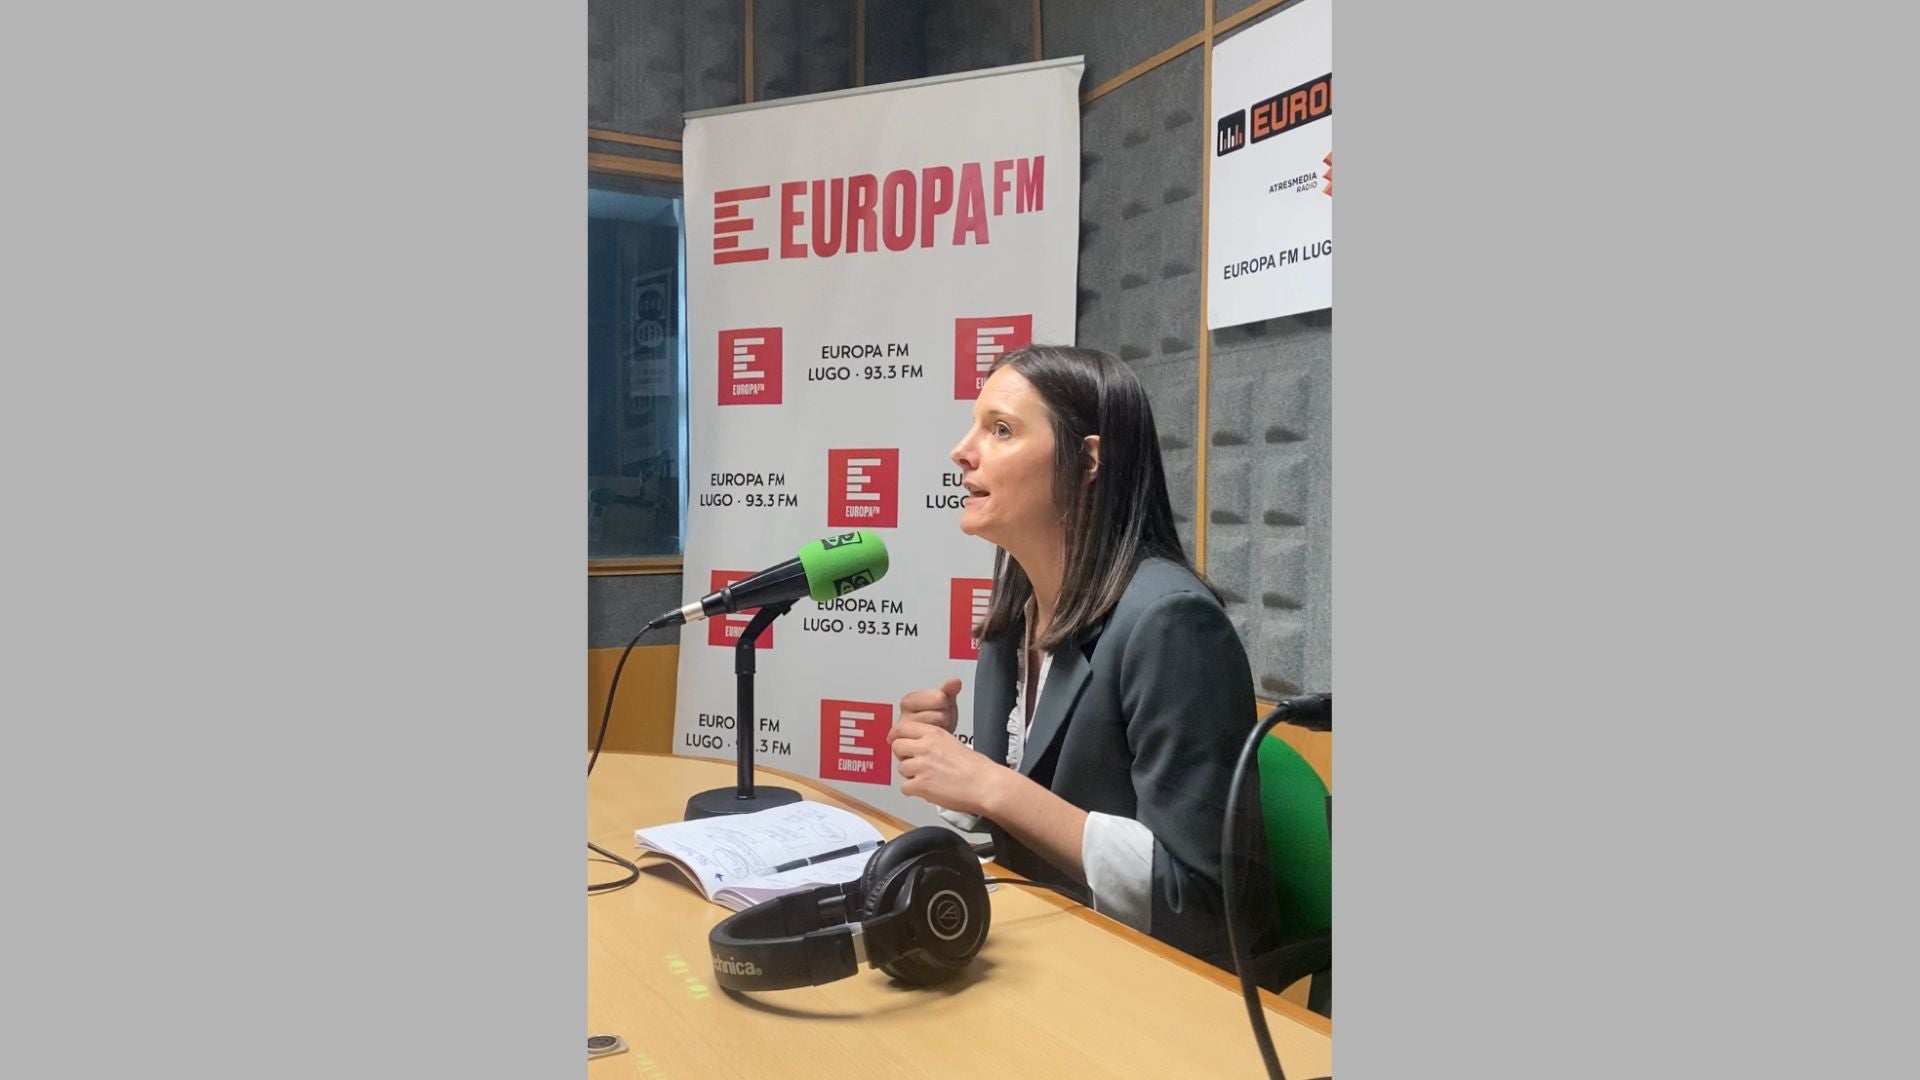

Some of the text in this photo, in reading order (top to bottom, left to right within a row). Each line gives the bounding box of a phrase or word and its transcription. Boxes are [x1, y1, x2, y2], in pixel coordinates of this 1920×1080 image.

[1253, 78, 1332, 138] EURO
[1269, 172, 1317, 193] ATRESMEDIA
[1297, 181, 1318, 193] RADIO
[1224, 254, 1276, 280] EUROPA
[1279, 248, 1298, 266] FM
[822, 343, 909, 359] EUROPA FM
[808, 365, 923, 381] LUGO 93.3 FM
[711, 473, 785, 486] EUROPA FM
[700, 494, 798, 507] LUGO 93.3 FM
[817, 598, 903, 614] EUROPA FM
[803, 619, 918, 637] LUGO 93.3 FM
[699, 714, 779, 733] EURO FM
[686, 733, 723, 749] LUGO
[772, 740, 791, 755] FM
